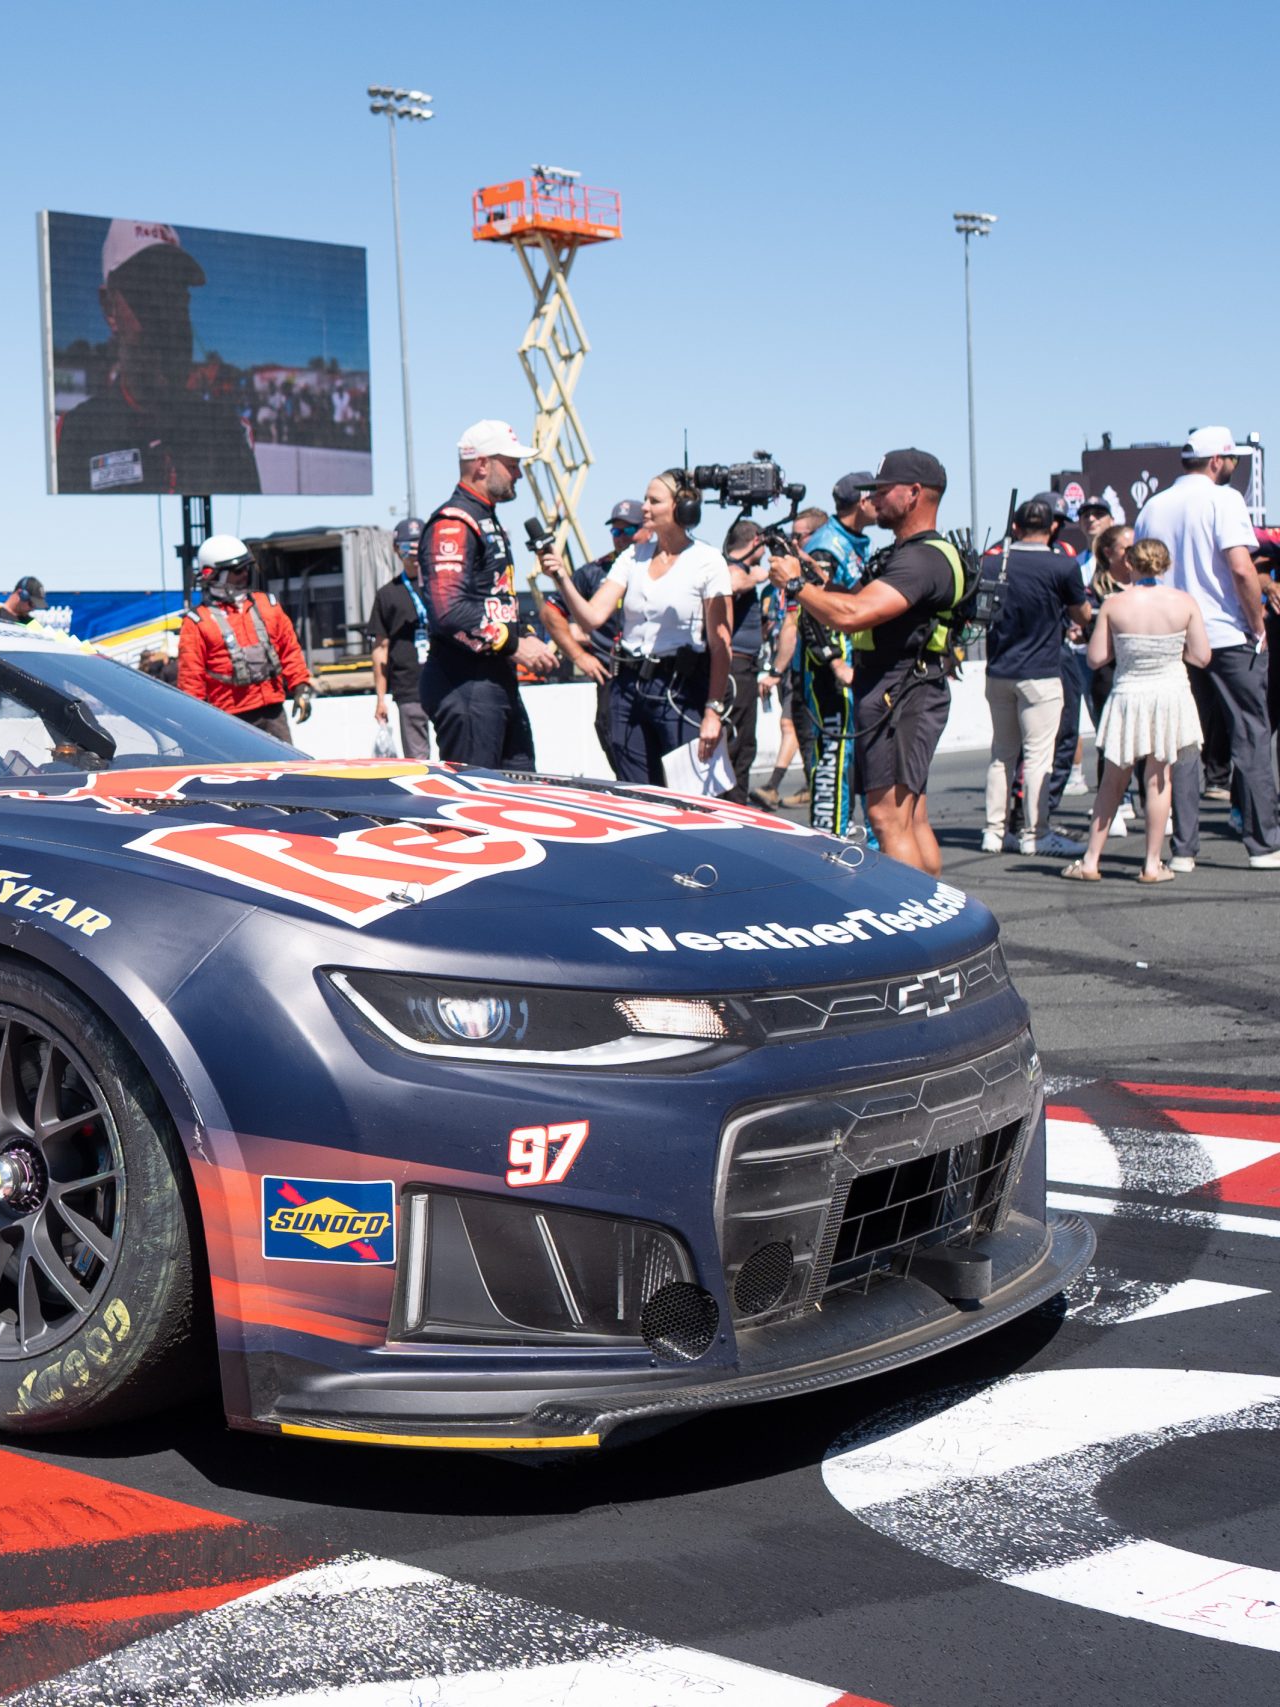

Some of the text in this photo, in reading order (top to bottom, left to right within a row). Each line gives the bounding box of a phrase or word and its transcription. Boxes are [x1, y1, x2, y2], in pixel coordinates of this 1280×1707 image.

[484, 597, 517, 622] Red
[122, 774, 667, 928] Red
[592, 883, 967, 953] WeatherTech.com
[505, 1120, 589, 1188] 97
[273, 1210, 387, 1234] SUNOCO
